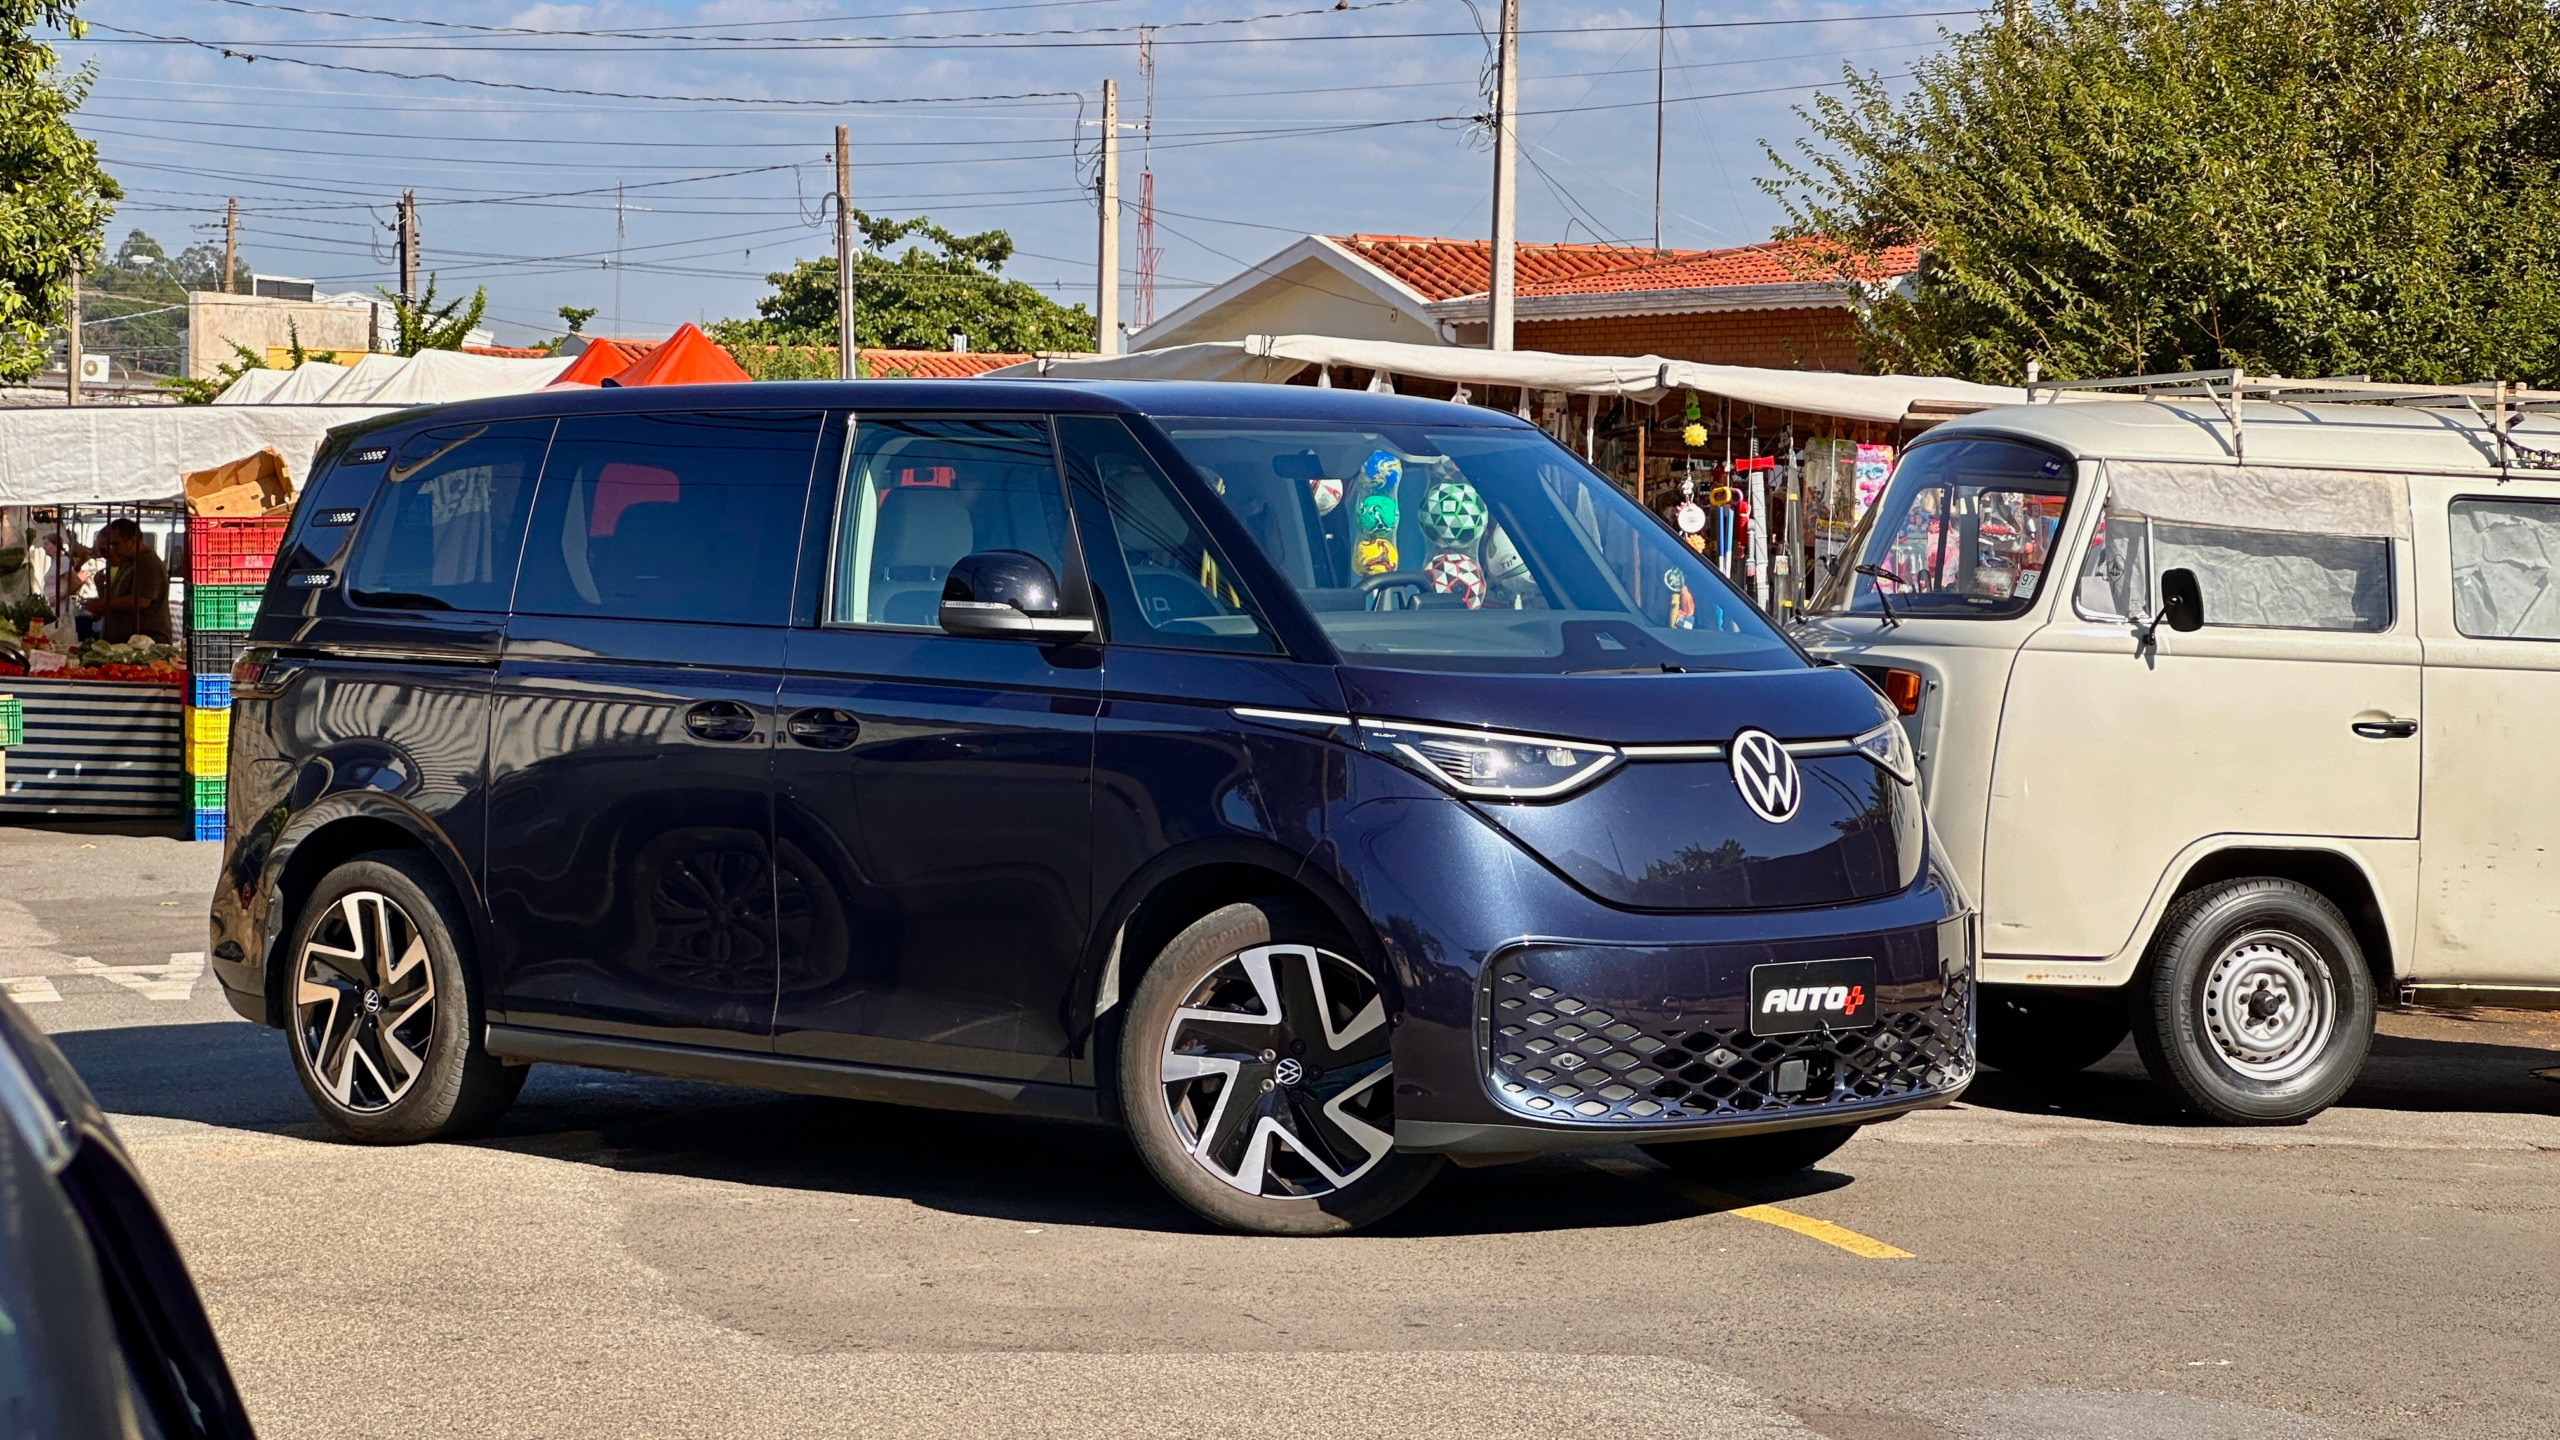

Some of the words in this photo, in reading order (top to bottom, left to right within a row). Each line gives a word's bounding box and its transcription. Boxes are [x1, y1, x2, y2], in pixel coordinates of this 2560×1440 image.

[2020, 573, 2036, 587] 97
[1736, 735, 1796, 815] VW
[1276, 1058, 1302, 1085] VW
